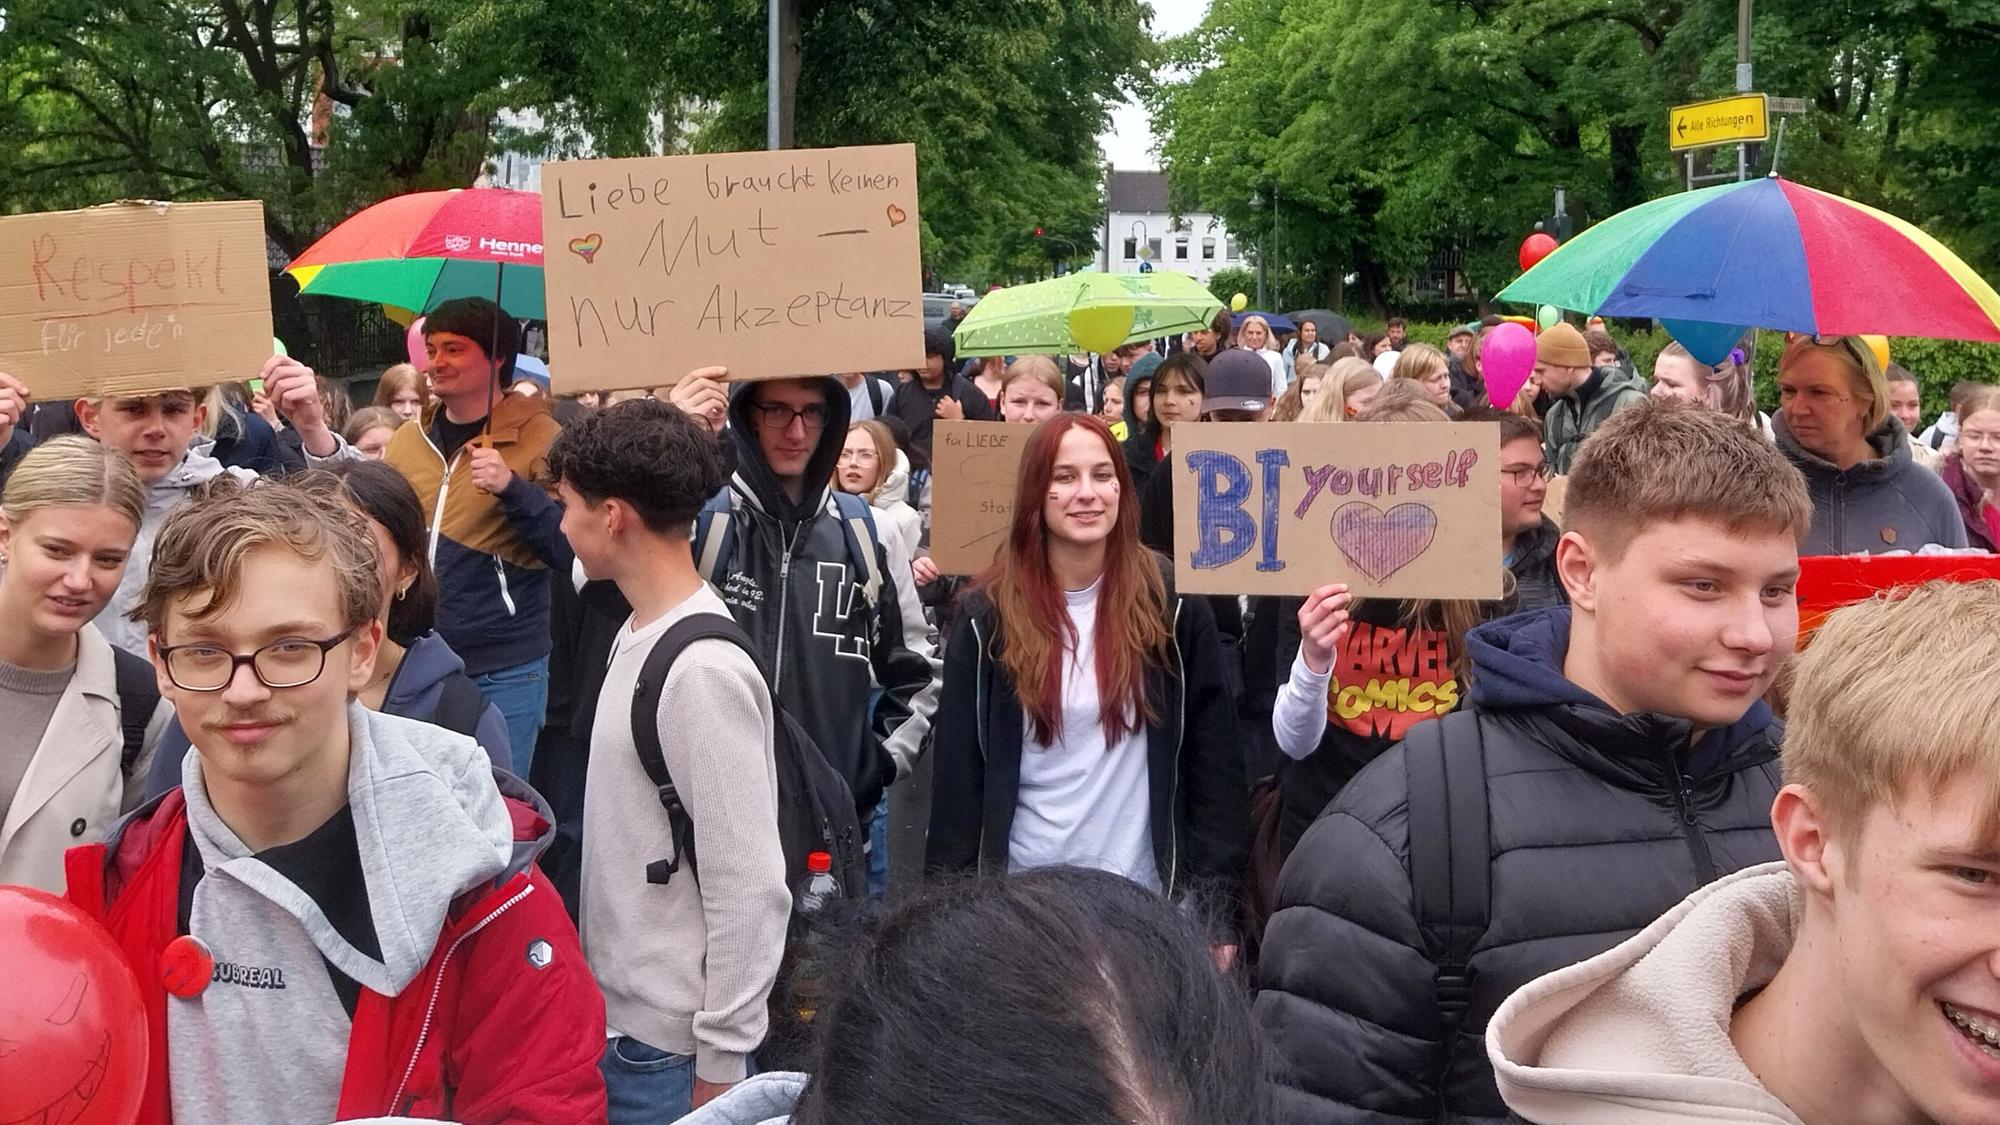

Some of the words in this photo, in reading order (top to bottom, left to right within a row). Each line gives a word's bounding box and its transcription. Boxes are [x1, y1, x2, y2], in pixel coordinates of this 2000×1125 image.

[1690, 119, 1704, 131] Alle
[1706, 114, 1754, 129] Richtungen
[558, 172, 672, 219] Liebe
[705, 163, 817, 199] braucht
[479, 237, 544, 254] Henne
[637, 207, 779, 276] Mut
[32, 231, 226, 315] Respekt
[696, 281, 916, 334] Akzeptanz
[966, 431, 1009, 448] LIEBE
[959, 454, 1017, 487] CS
[980, 498, 1013, 514] stat
[1185, 447, 1291, 573] BI
[1293, 447, 1479, 521] yourself
